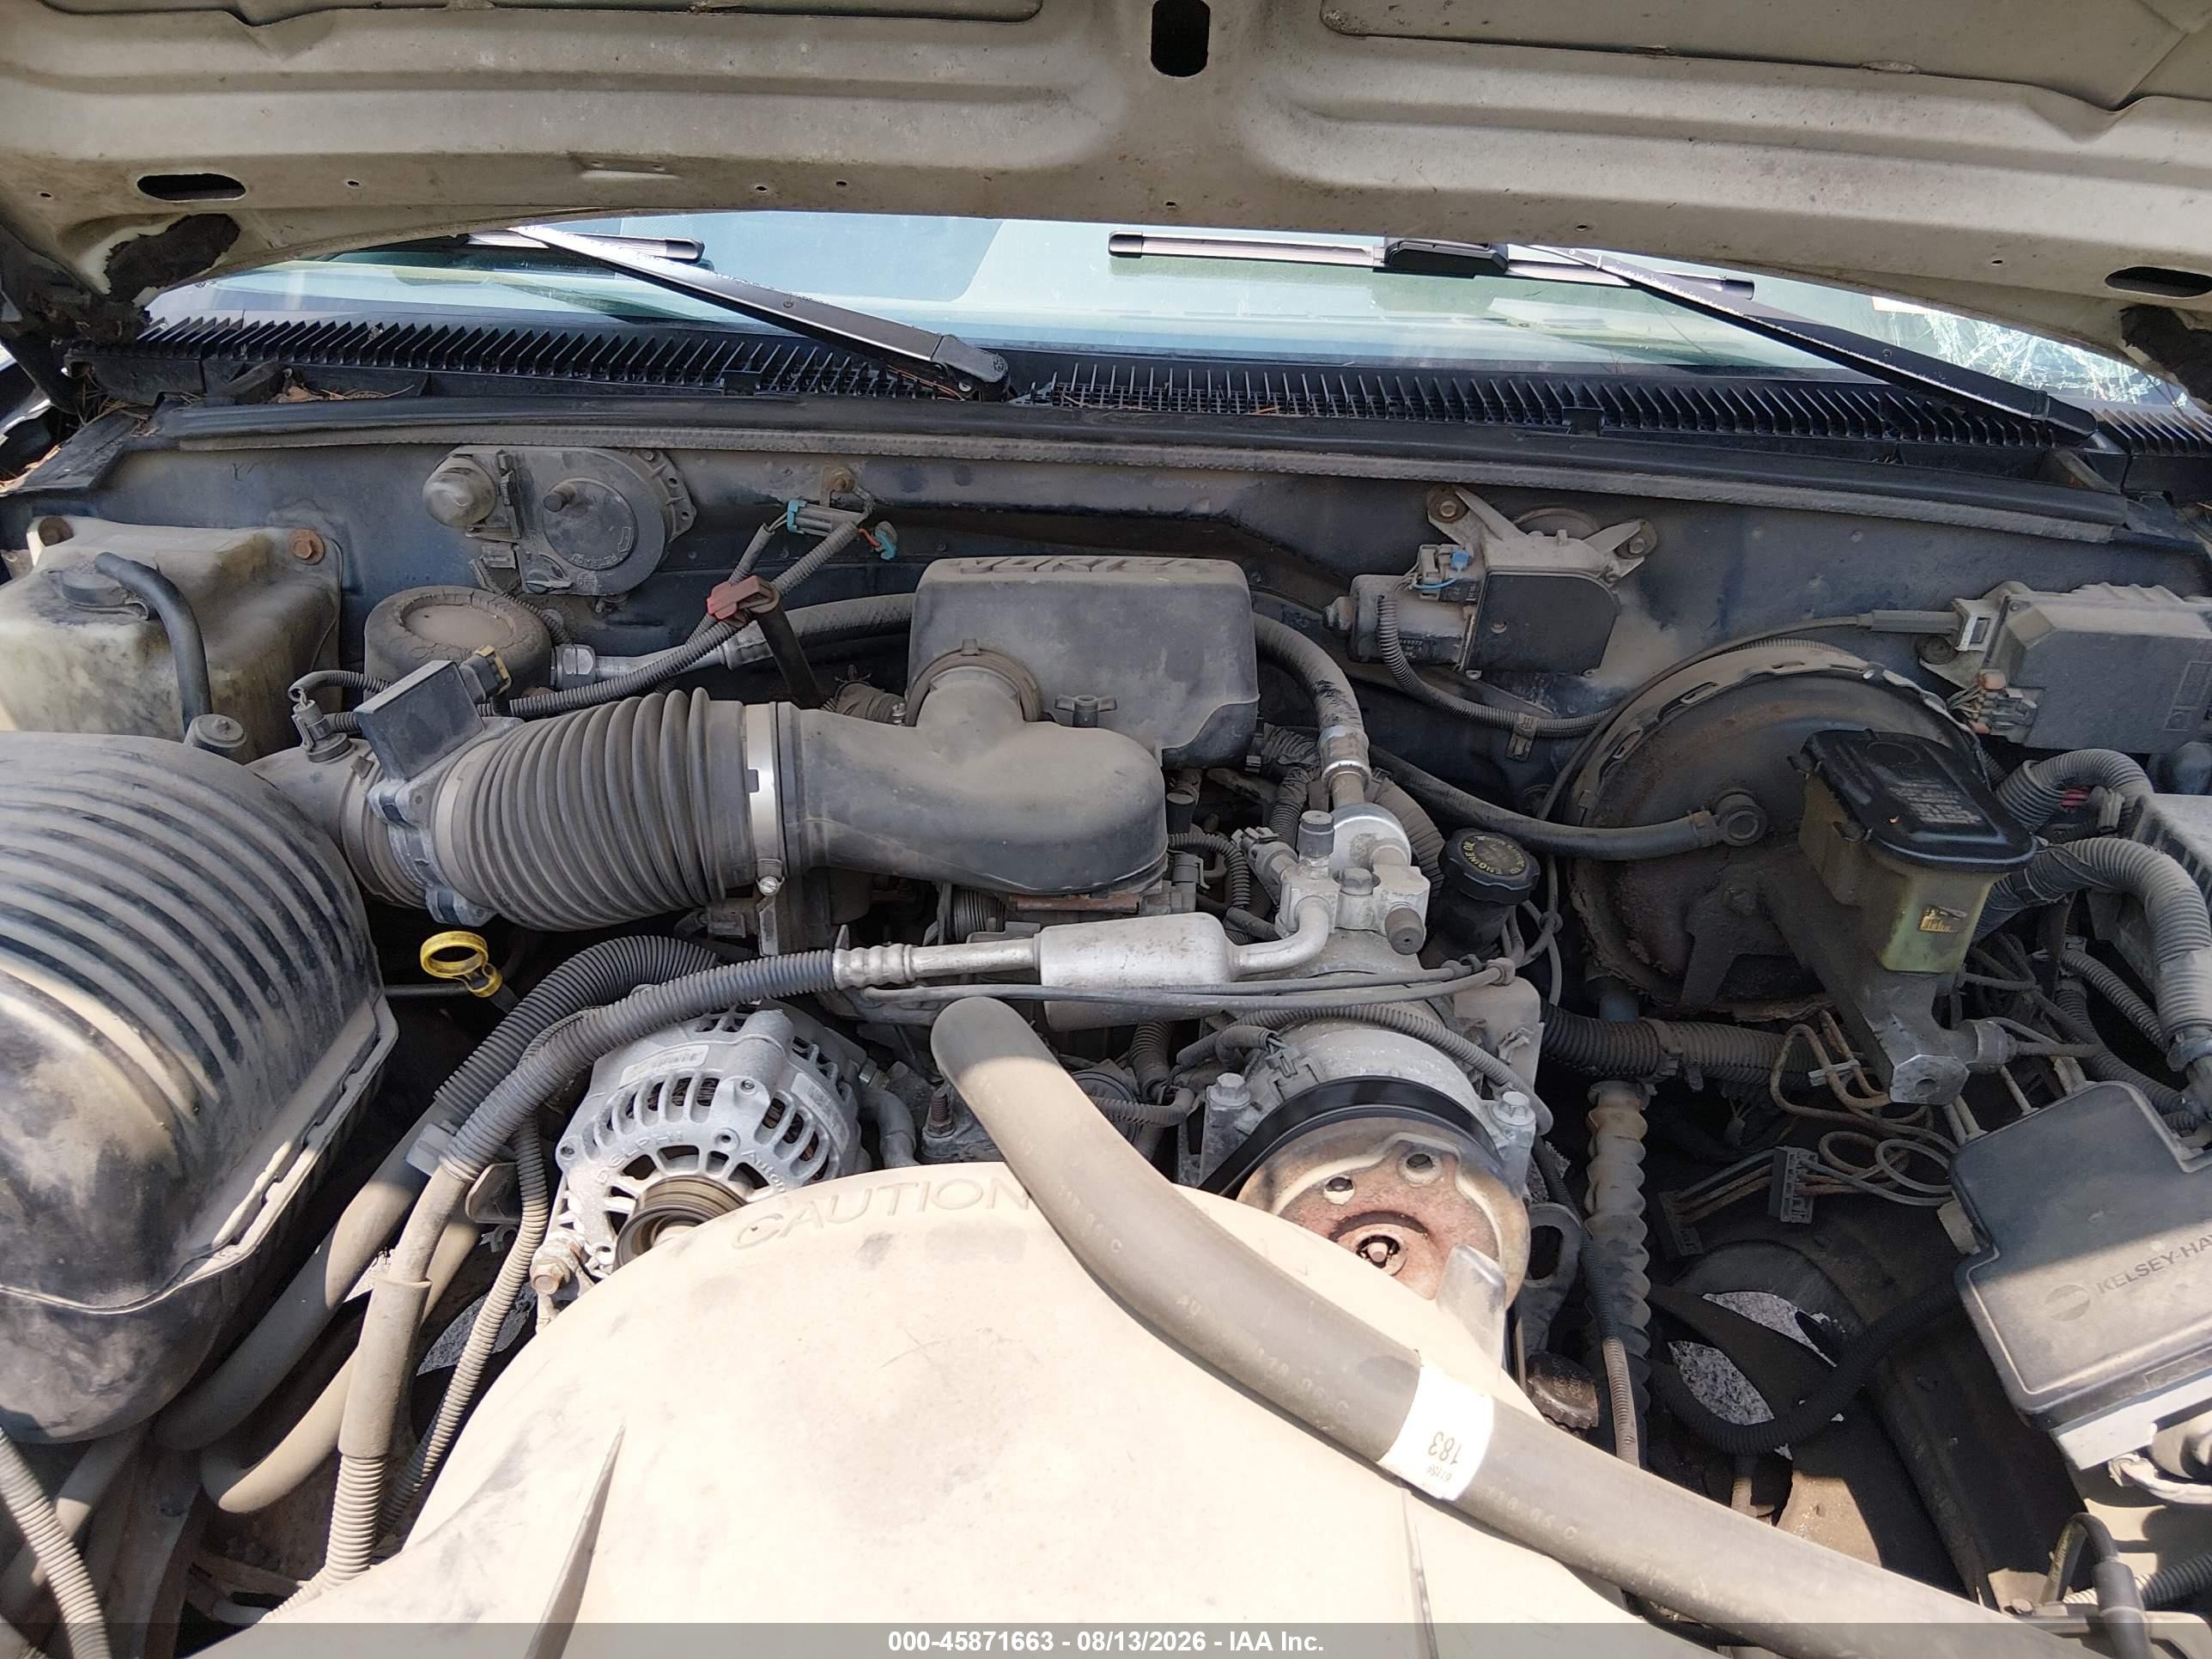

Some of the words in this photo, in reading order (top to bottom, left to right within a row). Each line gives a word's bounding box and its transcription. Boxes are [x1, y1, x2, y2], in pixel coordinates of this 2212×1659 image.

[596, 1130, 684, 1185] DELPHI
[732, 1176, 1032, 1250] CAUTION
[2095, 1234, 2212, 1295] KELSEY-HA
[1429, 1431, 1462, 1463] 183
